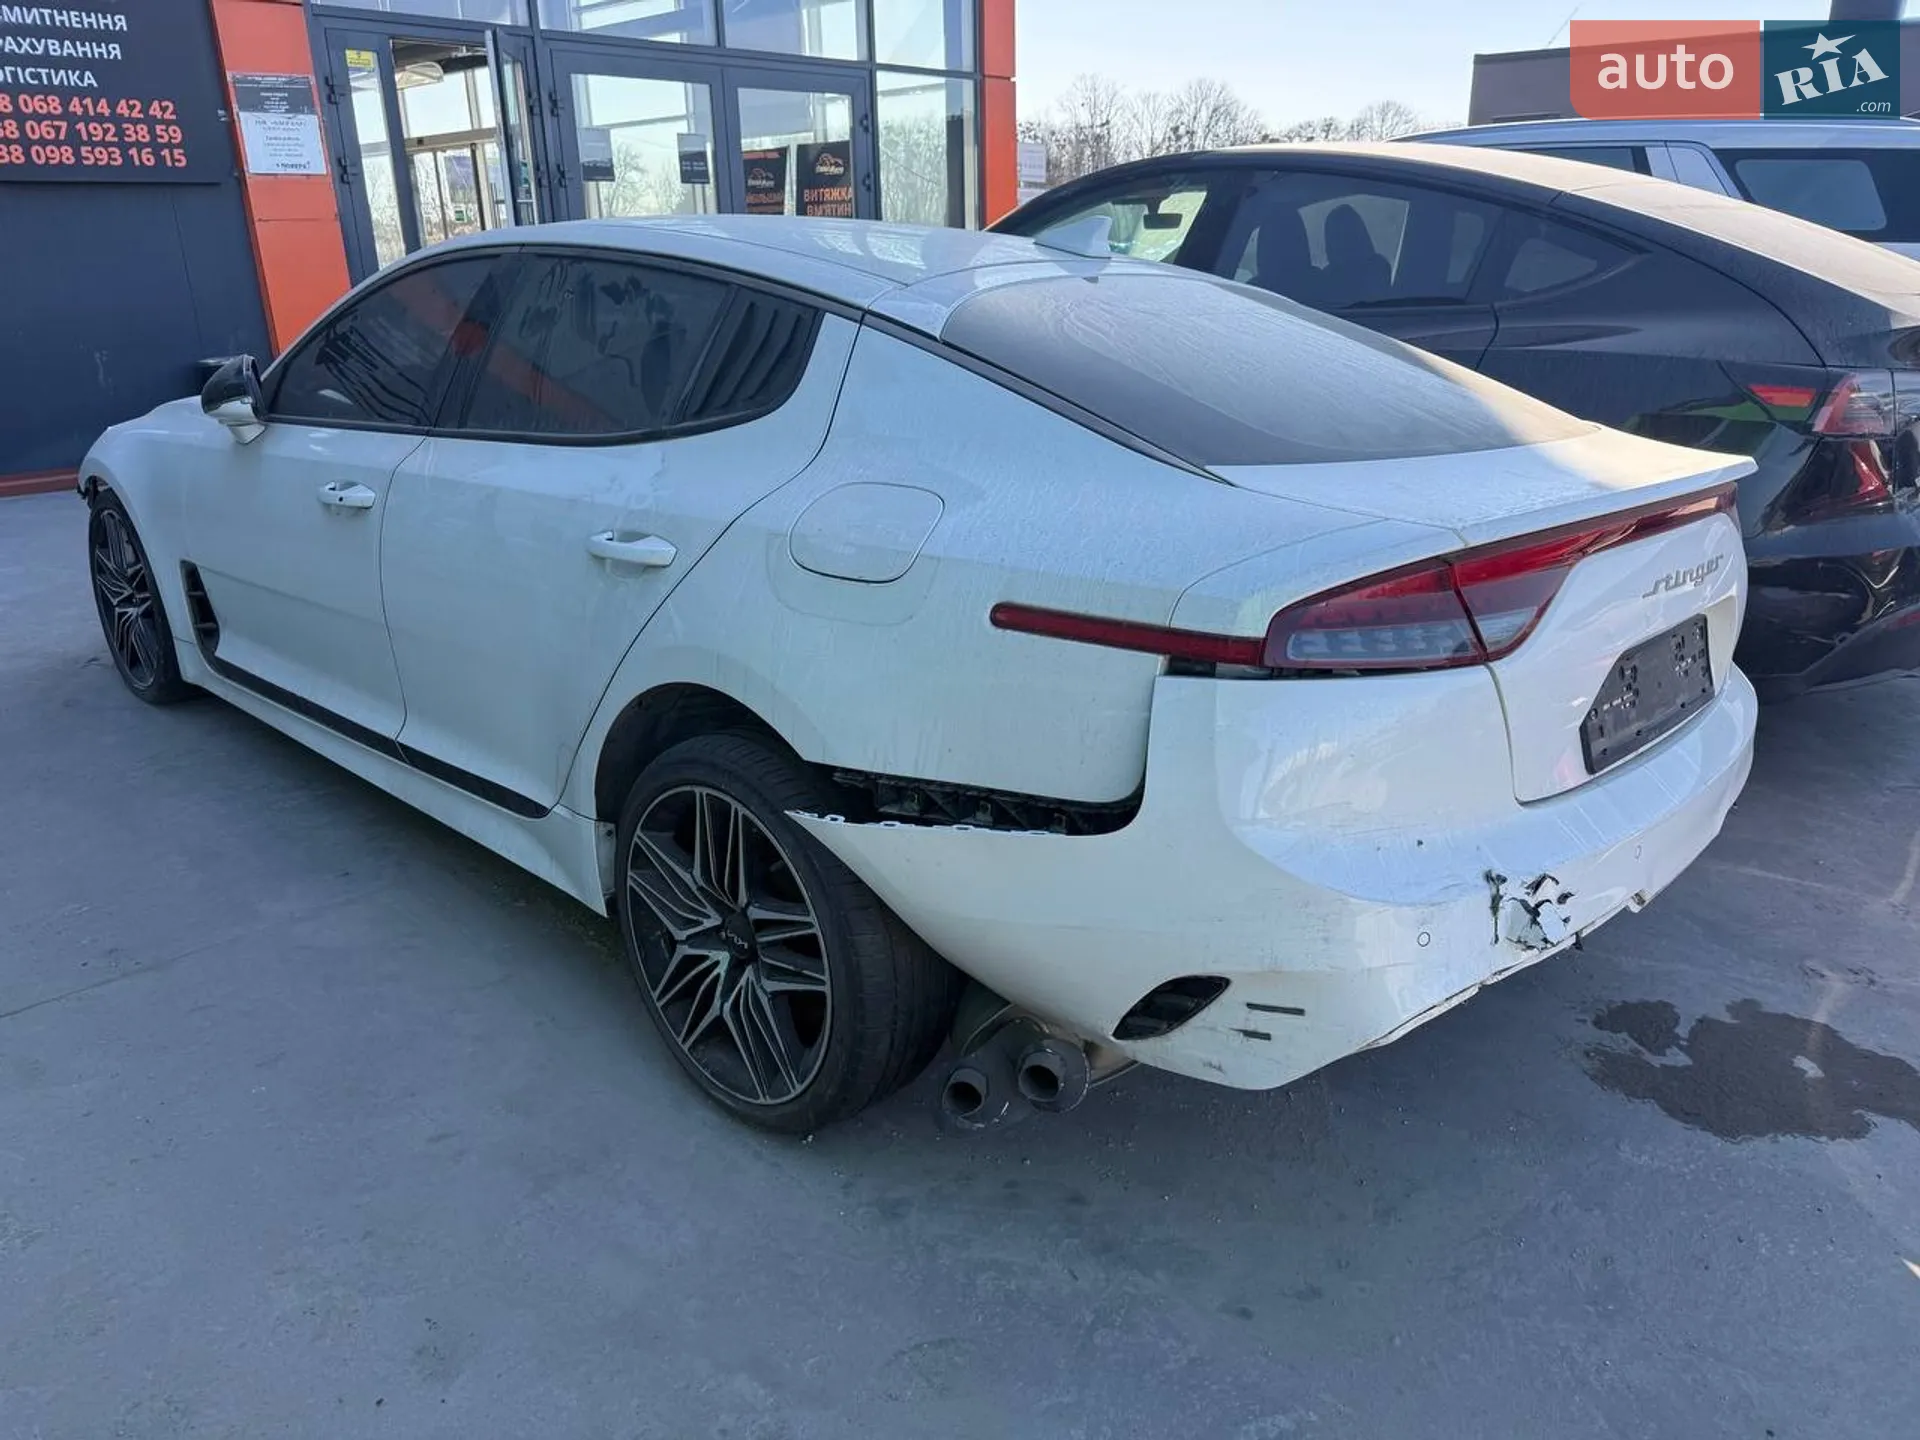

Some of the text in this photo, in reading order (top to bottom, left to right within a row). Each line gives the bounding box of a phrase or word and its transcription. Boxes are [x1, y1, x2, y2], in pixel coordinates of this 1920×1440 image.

[0, 5, 128, 31] МИТНЕННЯ
[0, 35, 122, 60] АХУВАННЯ
[18, 94, 63, 115] 068
[68, 97, 111, 117] 414
[115, 99, 144, 119] 42
[149, 100, 177, 120] 42
[0, 119, 183, 144] 8 067 192 38 59
[31, 145, 76, 165] 098
[81, 146, 124, 166] 593
[128, 147, 156, 167] 16
[161, 148, 188, 168] 15
